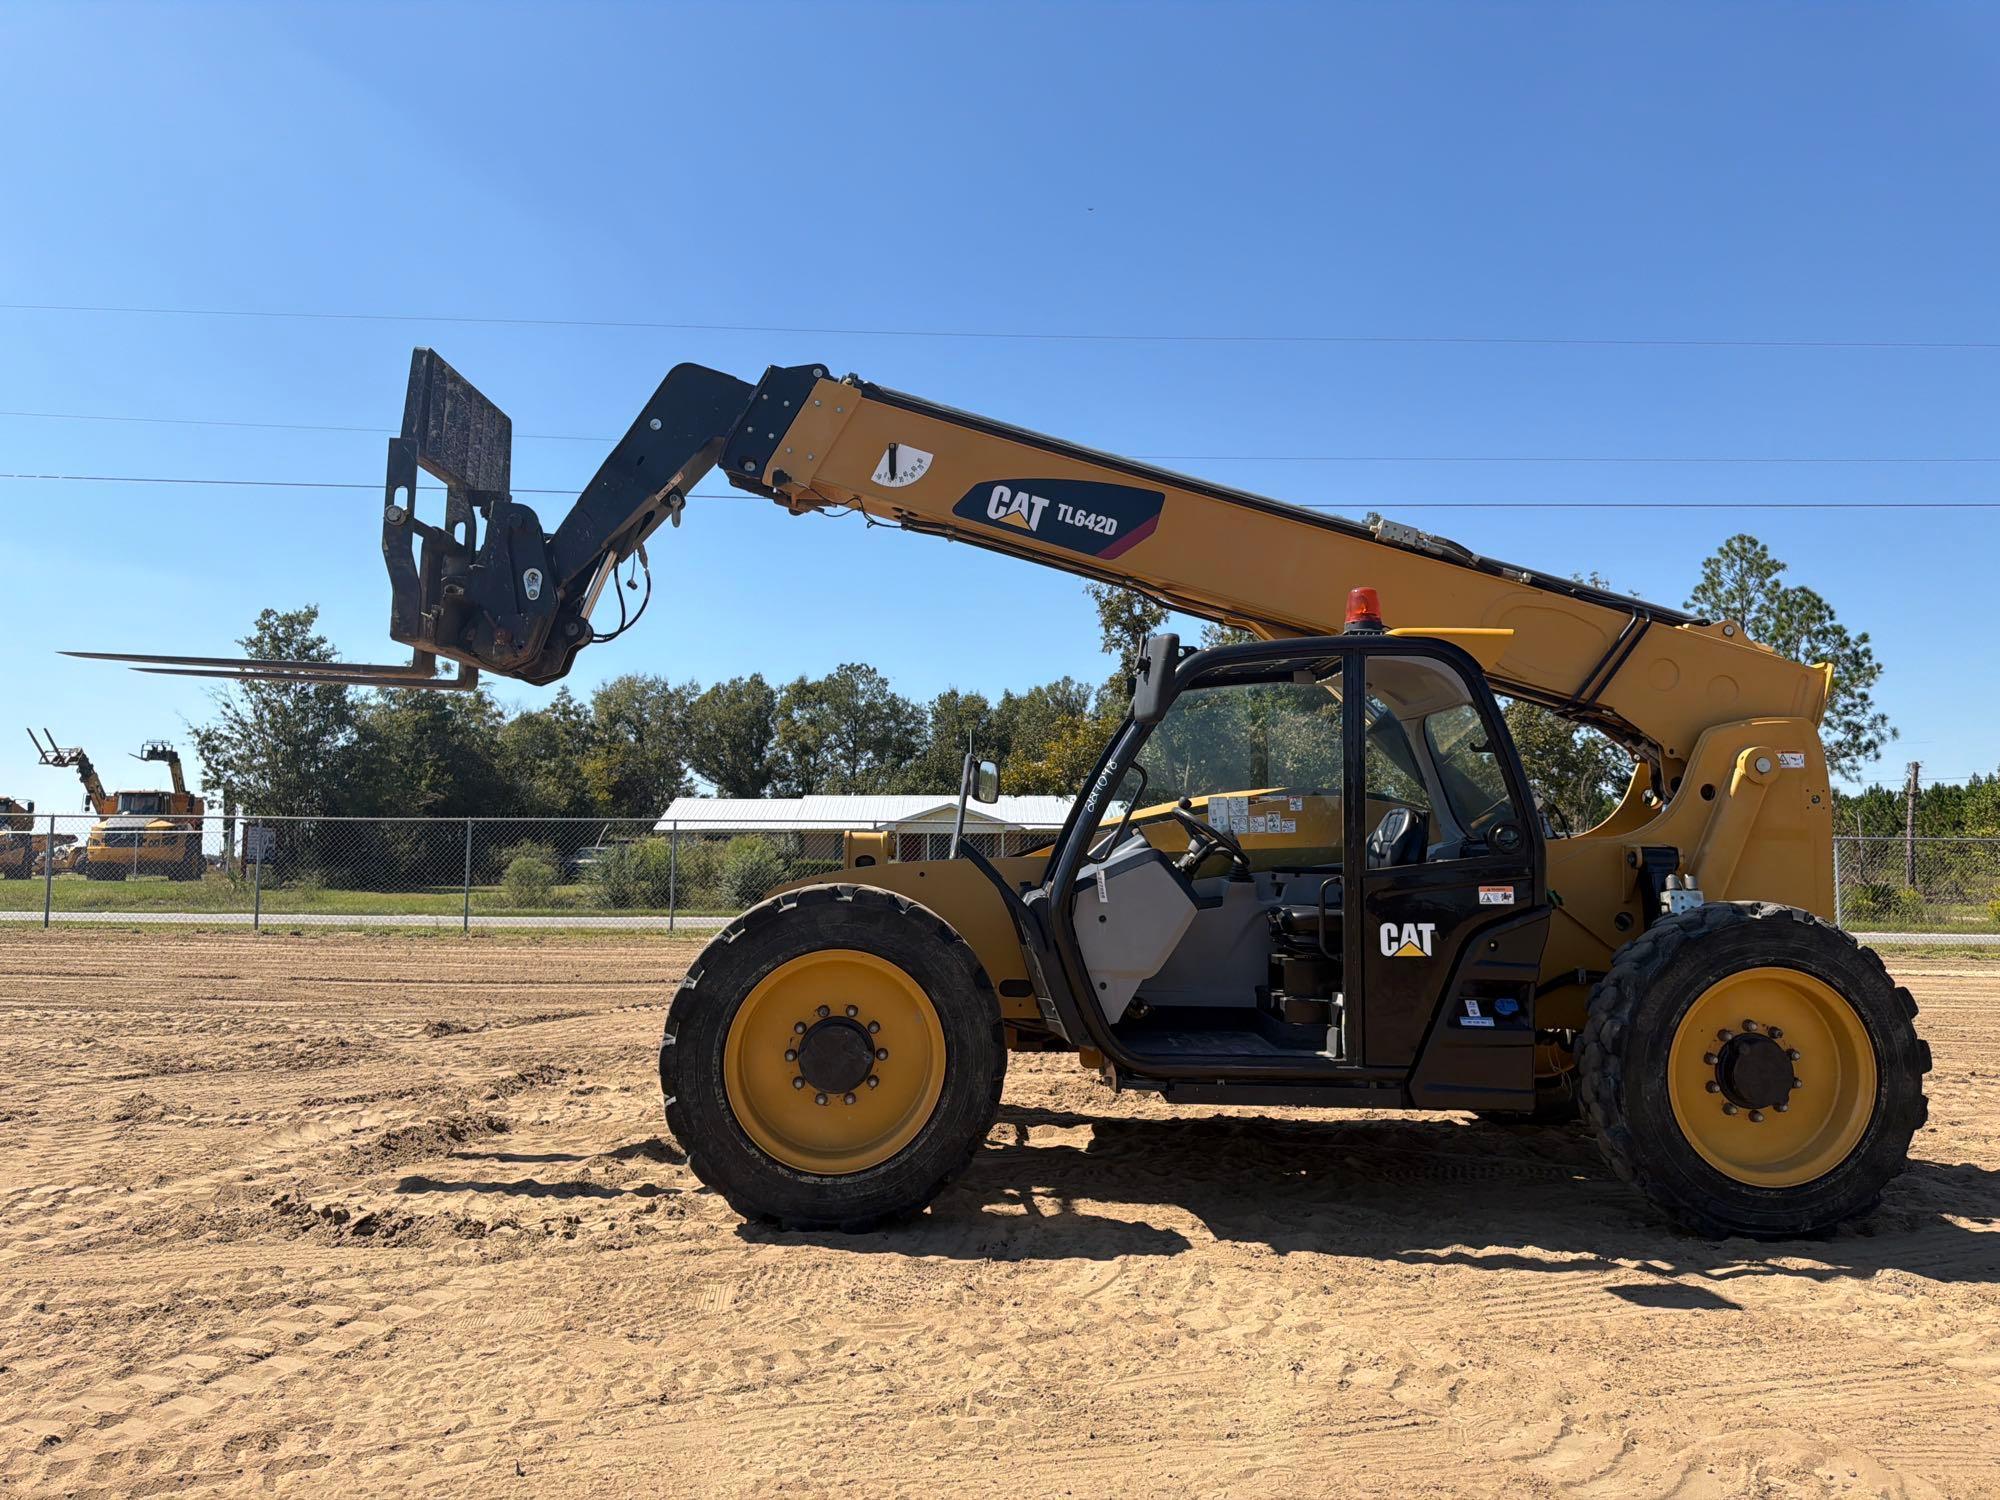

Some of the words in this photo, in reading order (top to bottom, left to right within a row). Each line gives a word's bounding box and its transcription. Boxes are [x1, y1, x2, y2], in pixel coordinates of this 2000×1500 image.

[987, 485, 1050, 532] CAT
[1057, 503, 1118, 536] TL642D
[1379, 922, 1436, 957] CAT
